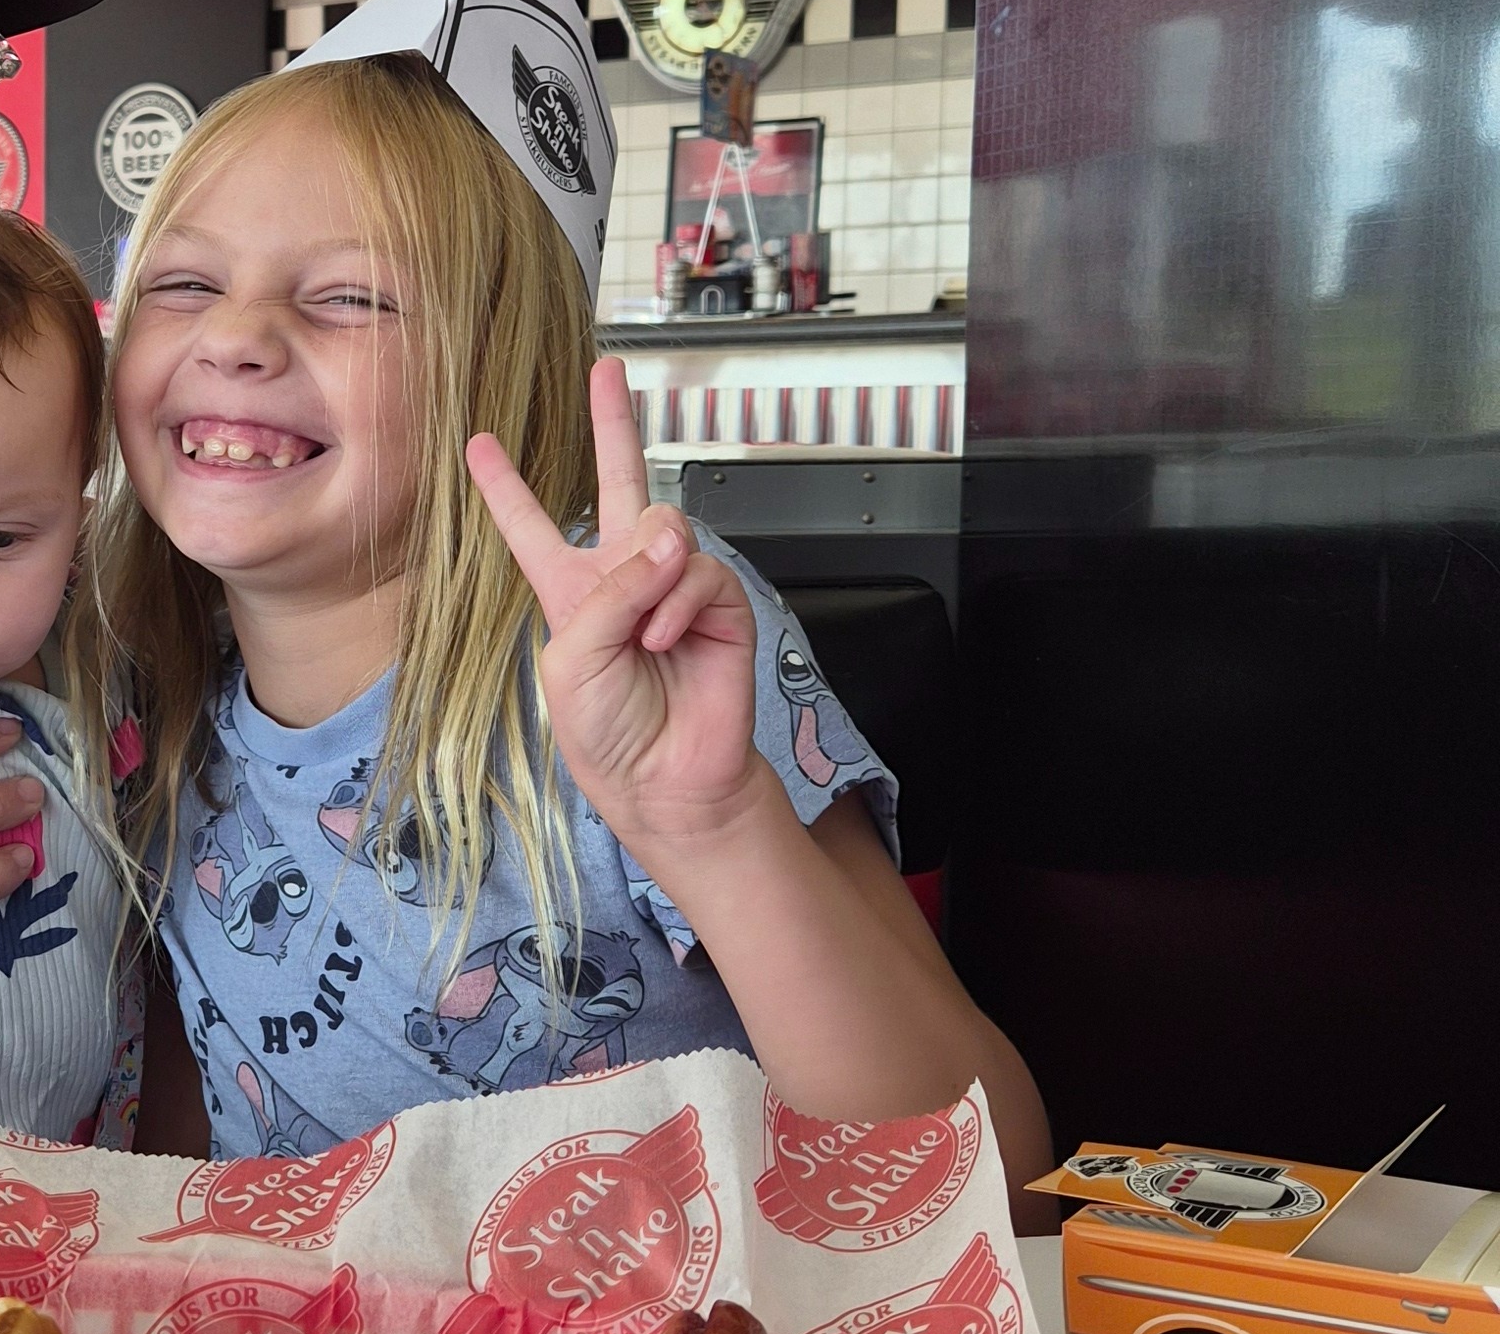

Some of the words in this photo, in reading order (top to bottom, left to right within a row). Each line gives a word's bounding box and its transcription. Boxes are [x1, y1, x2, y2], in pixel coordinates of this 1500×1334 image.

[543, 85, 581, 152] Steak
[549, 70, 582, 111] FAMOUS
[122, 129, 175, 150] 100%
[519, 115, 574, 190] STEAKBURGERS
[530, 106, 574, 174] Shake
[250, 1152, 367, 1239] Shake
[473, 1167, 537, 1258] FAMOUS
[541, 1138, 591, 1168] FOR
[826, 1129, 948, 1226] Shake
[862, 1116, 976, 1247] STEAKBURGERS
[497, 1167, 620, 1269] Steak
[206, 1286, 261, 1313] FOR
[546, 1208, 679, 1319] Shake
[838, 1303, 895, 1334] FOR
